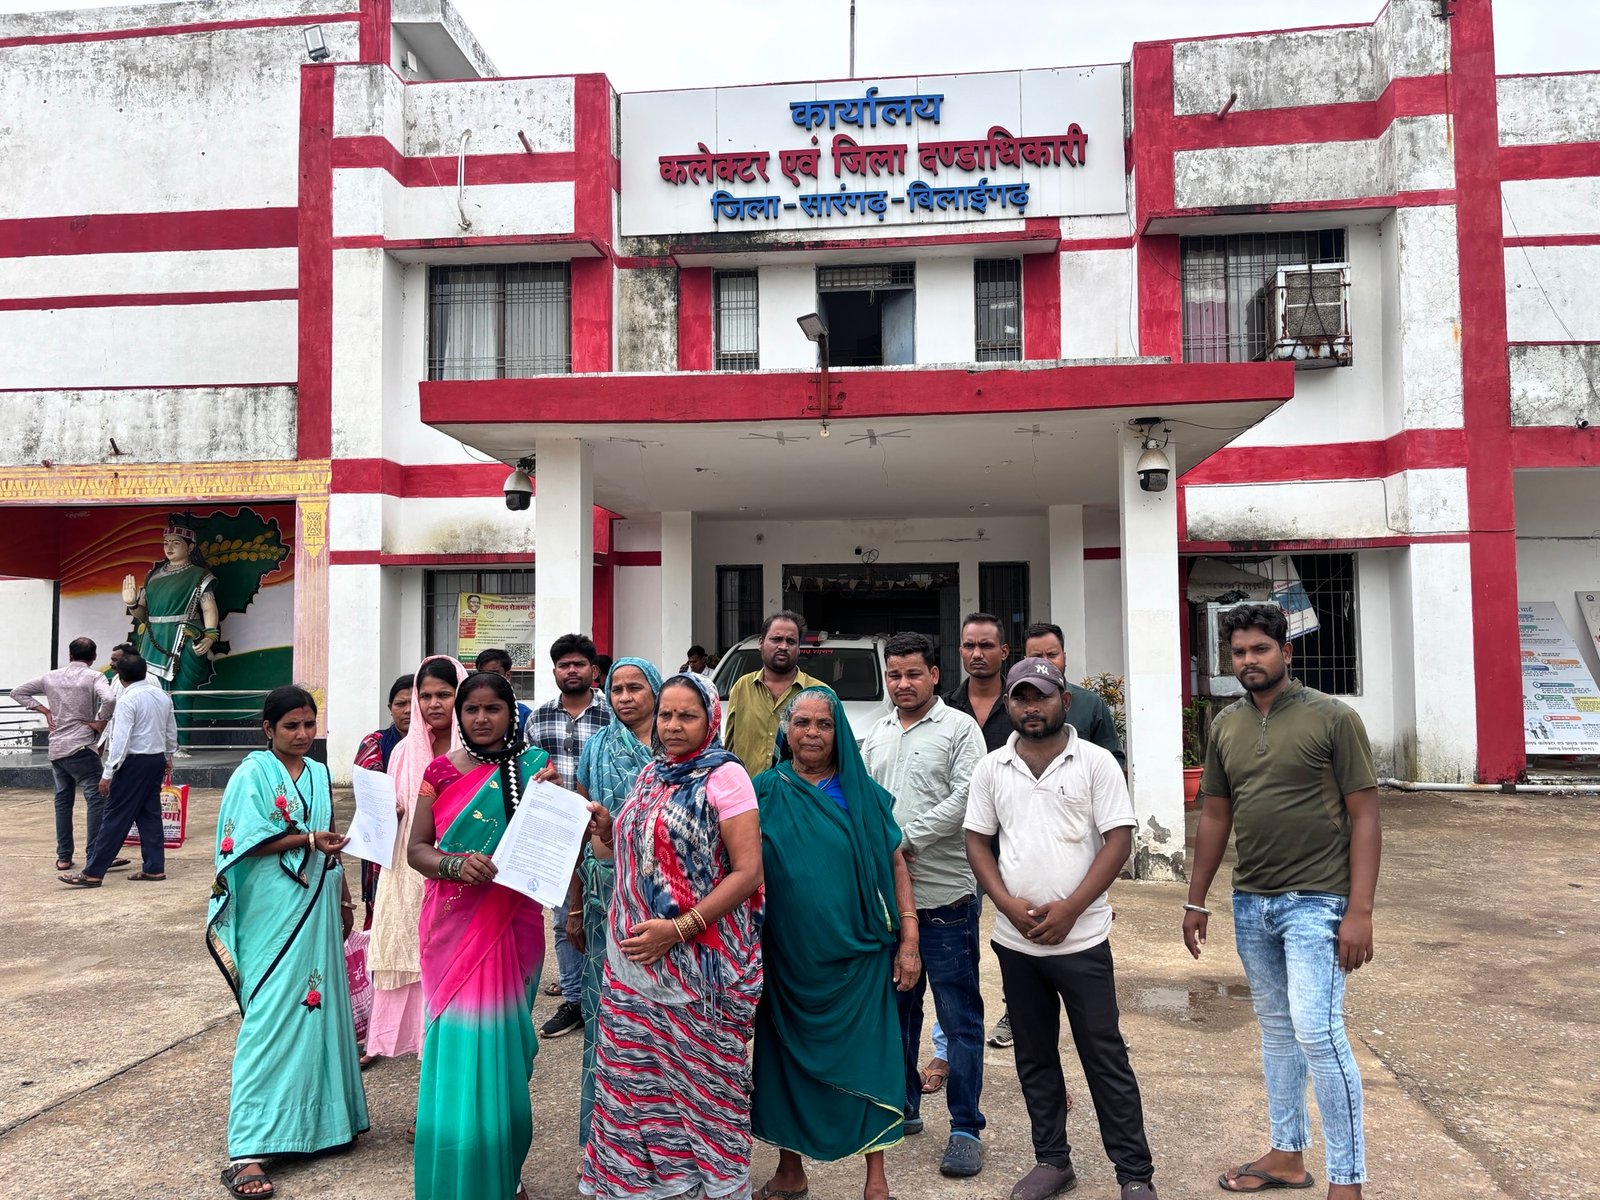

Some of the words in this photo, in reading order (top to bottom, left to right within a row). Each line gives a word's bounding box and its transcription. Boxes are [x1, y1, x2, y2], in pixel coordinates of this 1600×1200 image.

[790, 86, 945, 132] कार्यालय
[658, 142, 771, 186] कलेक्टर
[778, 135, 822, 187] एवं
[831, 133, 908, 179] जिला
[917, 122, 1089, 177] दण्डाधिकारी
